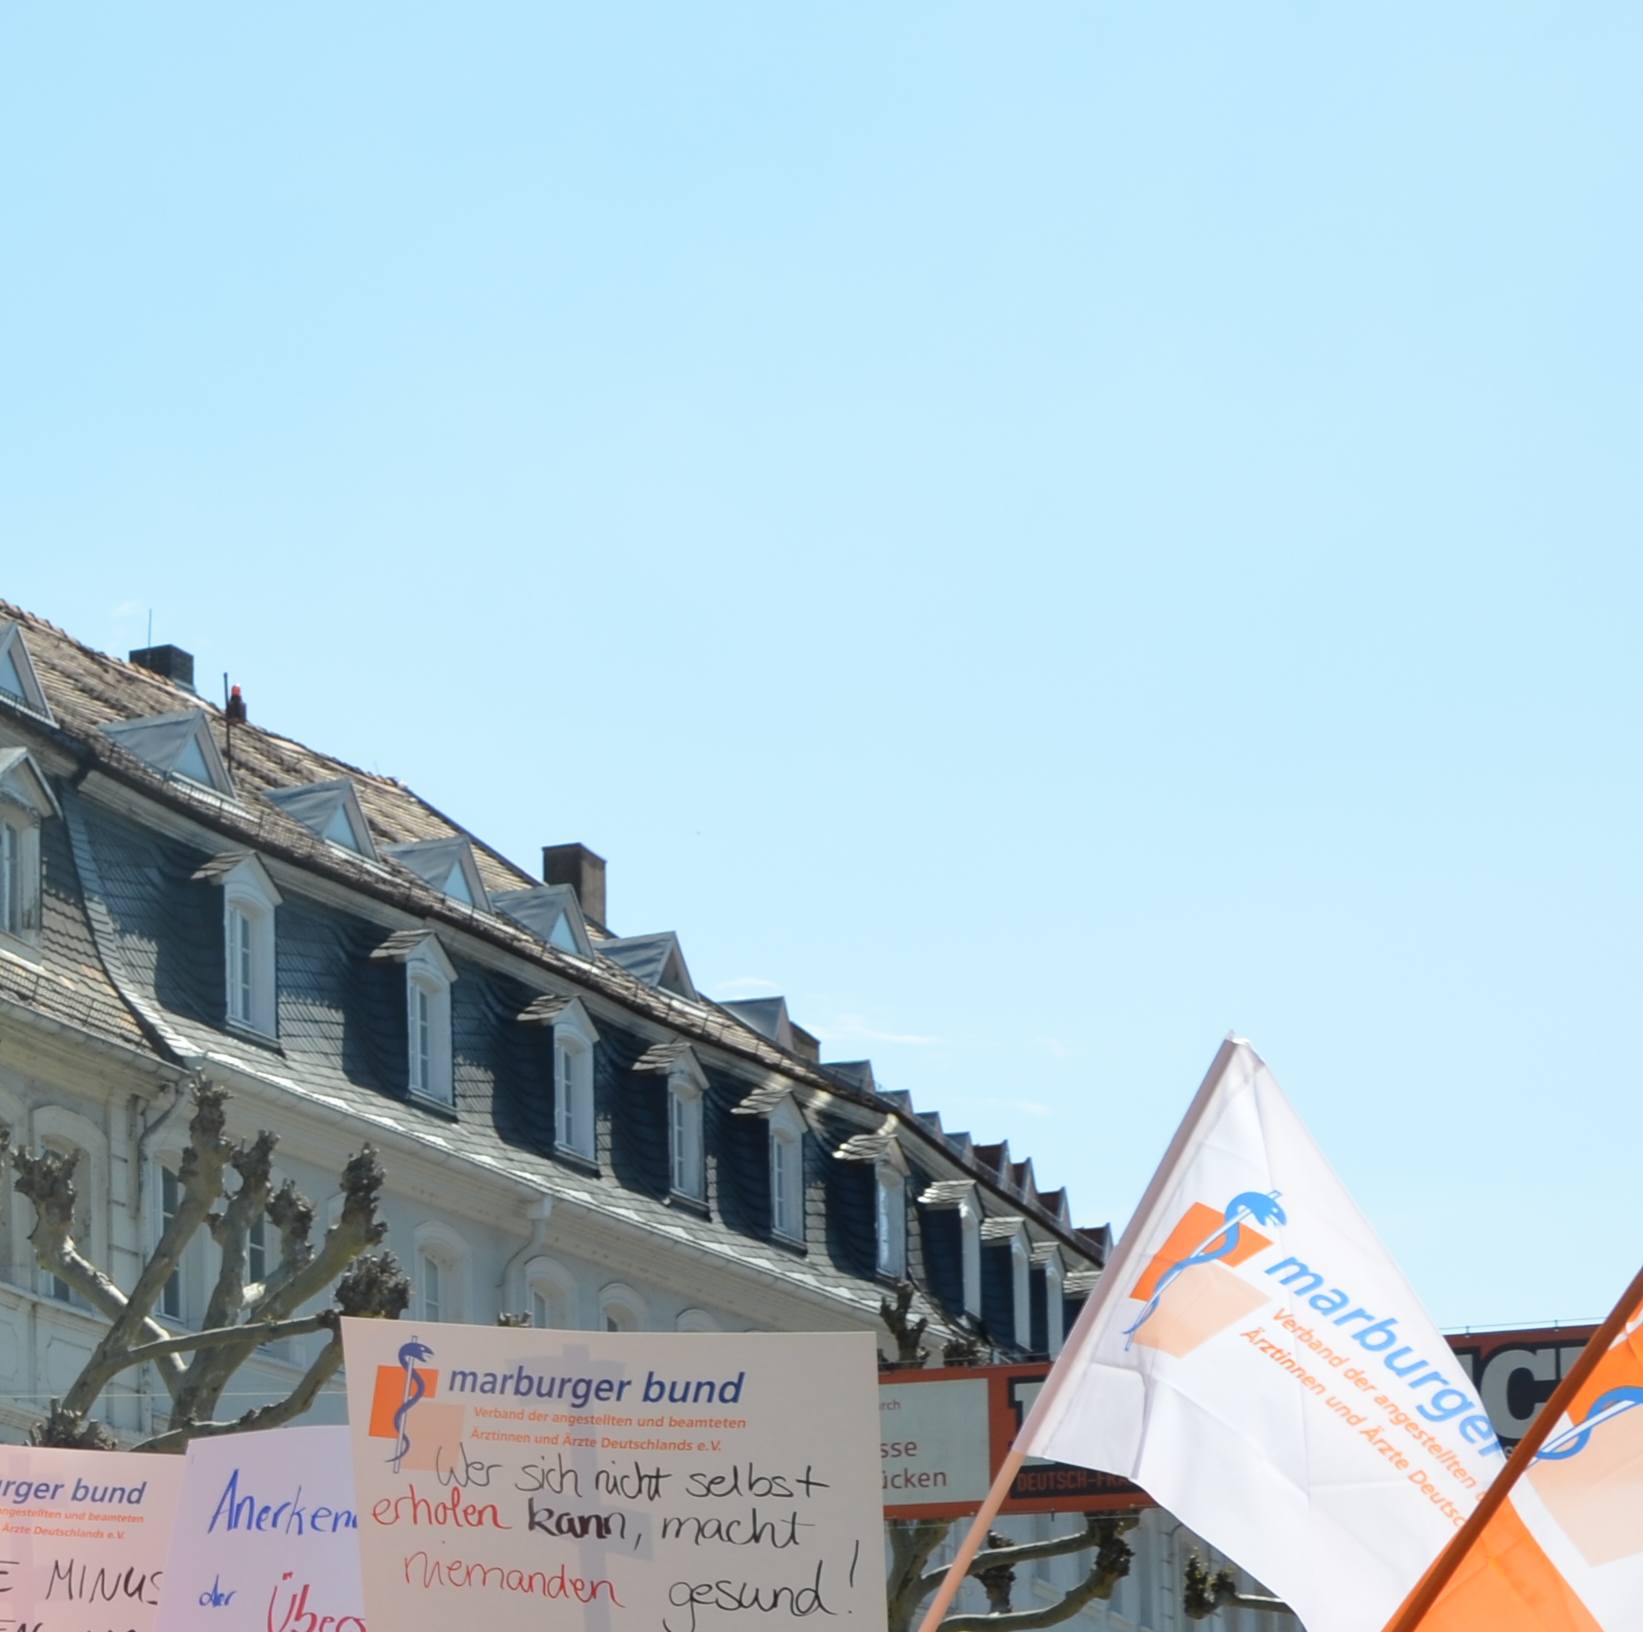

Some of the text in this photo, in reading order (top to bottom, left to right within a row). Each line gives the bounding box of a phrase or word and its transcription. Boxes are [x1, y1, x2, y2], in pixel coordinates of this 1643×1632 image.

[1264, 1256, 1503, 1459] marburger
[448, 1365, 746, 1408] marburger bund
[1240, 1327, 1326, 1397] Ärztinnen
[1325, 1395, 1366, 1428] und
[1360, 1424, 1409, 1470] Ärzte
[1272, 1307, 1349, 1369] Verband
[1343, 1360, 1378, 1394] der
[1374, 1391, 1478, 1490] angestellten
[473, 1407, 747, 1429] Verband der angestellten und beamteten
[470, 1428, 722, 1452] Ärztinnen und Ärzte Deutschlands e.V.
[434, 1442, 831, 1501] Wer sich nicht selbst
[70, 1477, 148, 1505] bund
[1, 1522, 31, 1536] Ärzte
[33, 1525, 105, 1539] Deutschlands
[106, 1530, 125, 1540] e.V.
[64, 1511, 86, 1521] und
[88, 1512, 145, 1524] beamteten
[371, 1484, 817, 1551] erholen kann, macht
[199, 1574, 238, 1608] der
